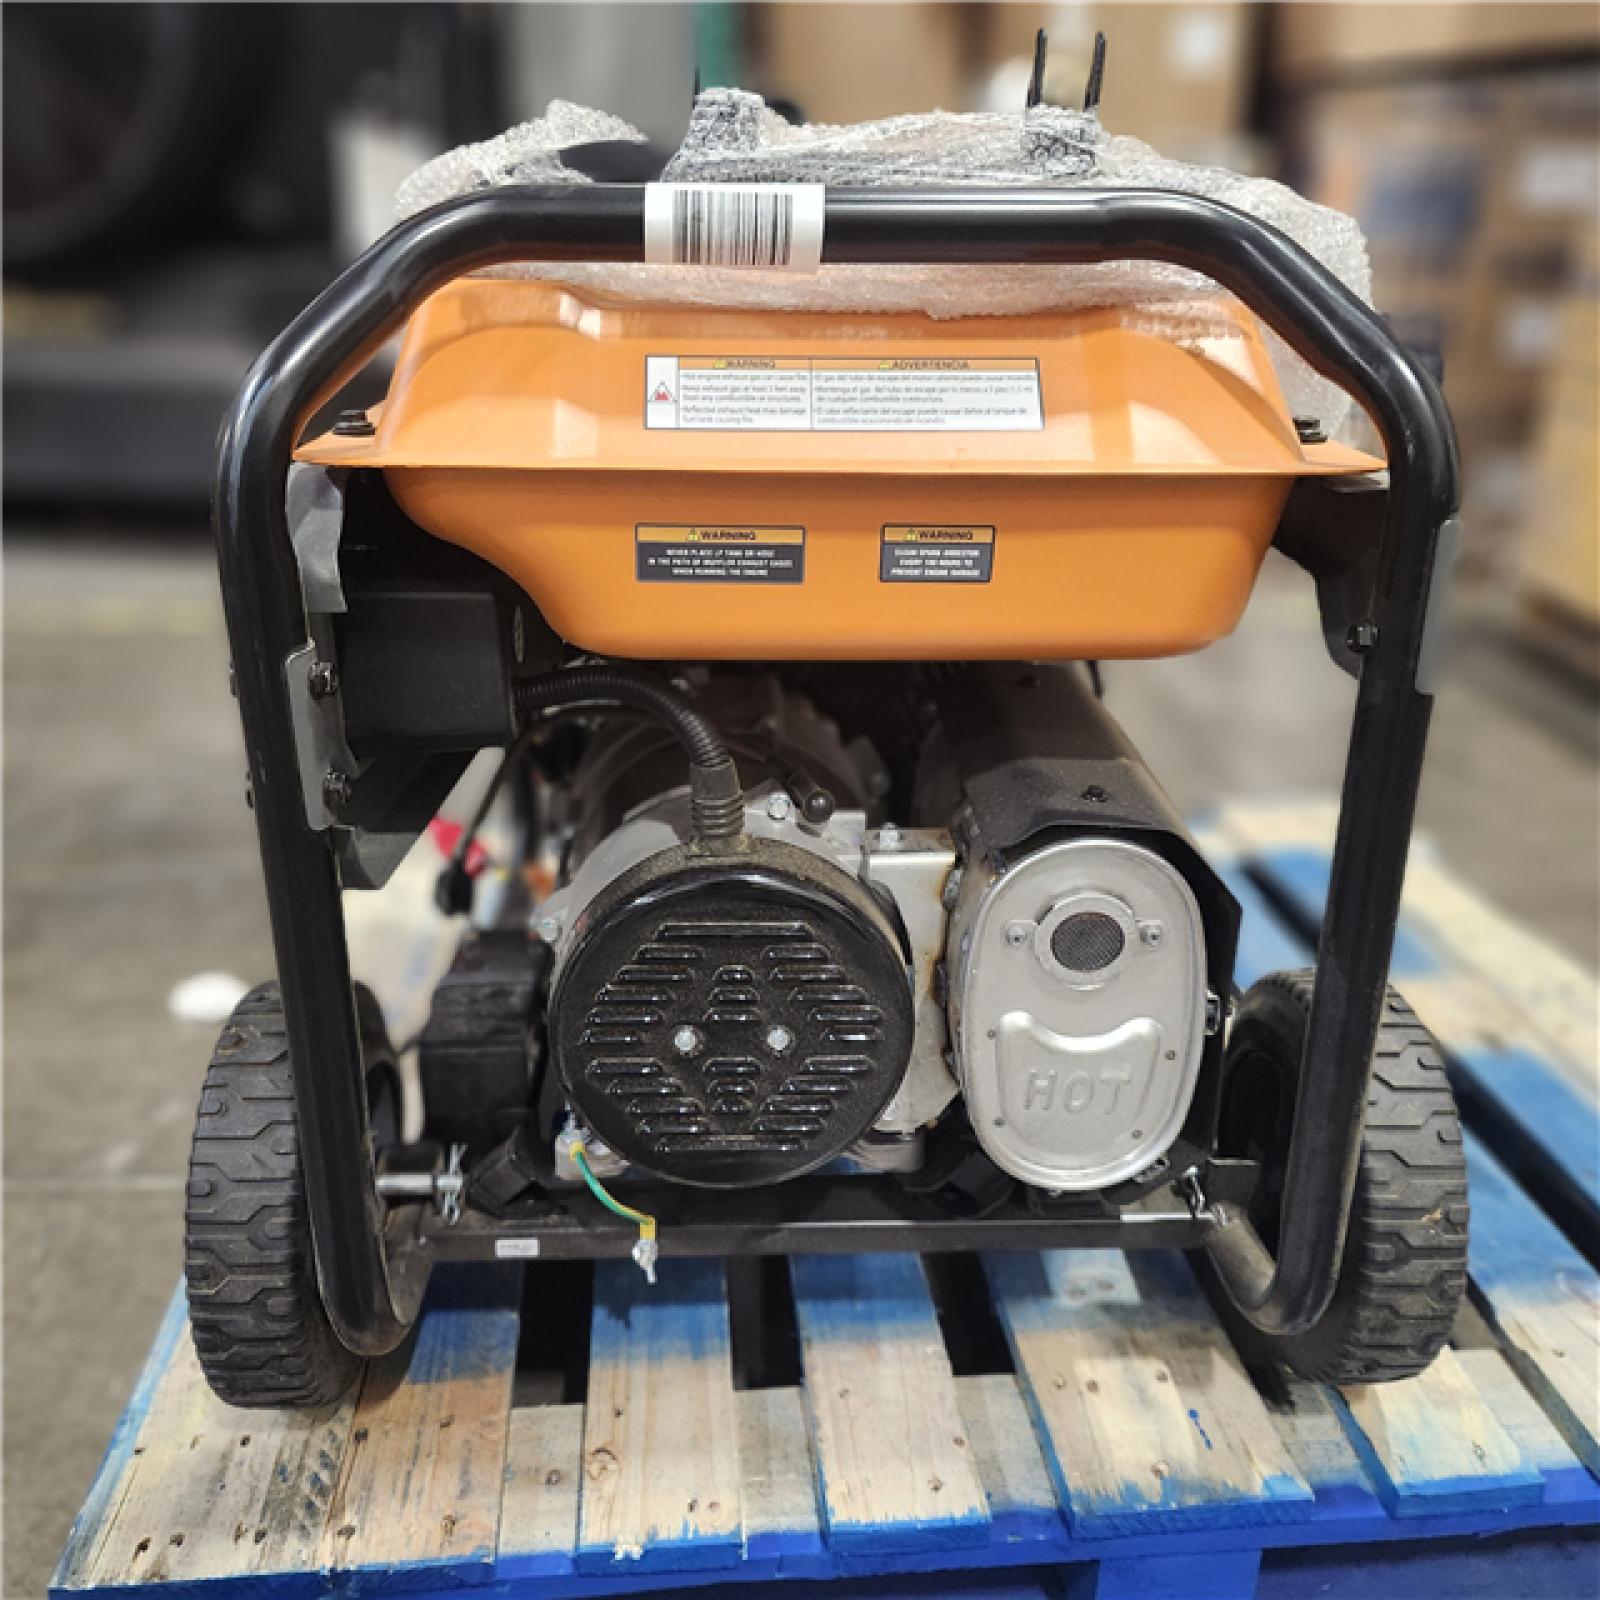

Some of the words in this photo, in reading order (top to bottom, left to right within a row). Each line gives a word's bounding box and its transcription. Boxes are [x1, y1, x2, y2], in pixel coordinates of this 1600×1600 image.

[726, 358, 776, 369] WARNING
[701, 529, 756, 541] WARNING
[919, 529, 974, 541] WARNING
[1022, 1067, 1132, 1117] HOT
